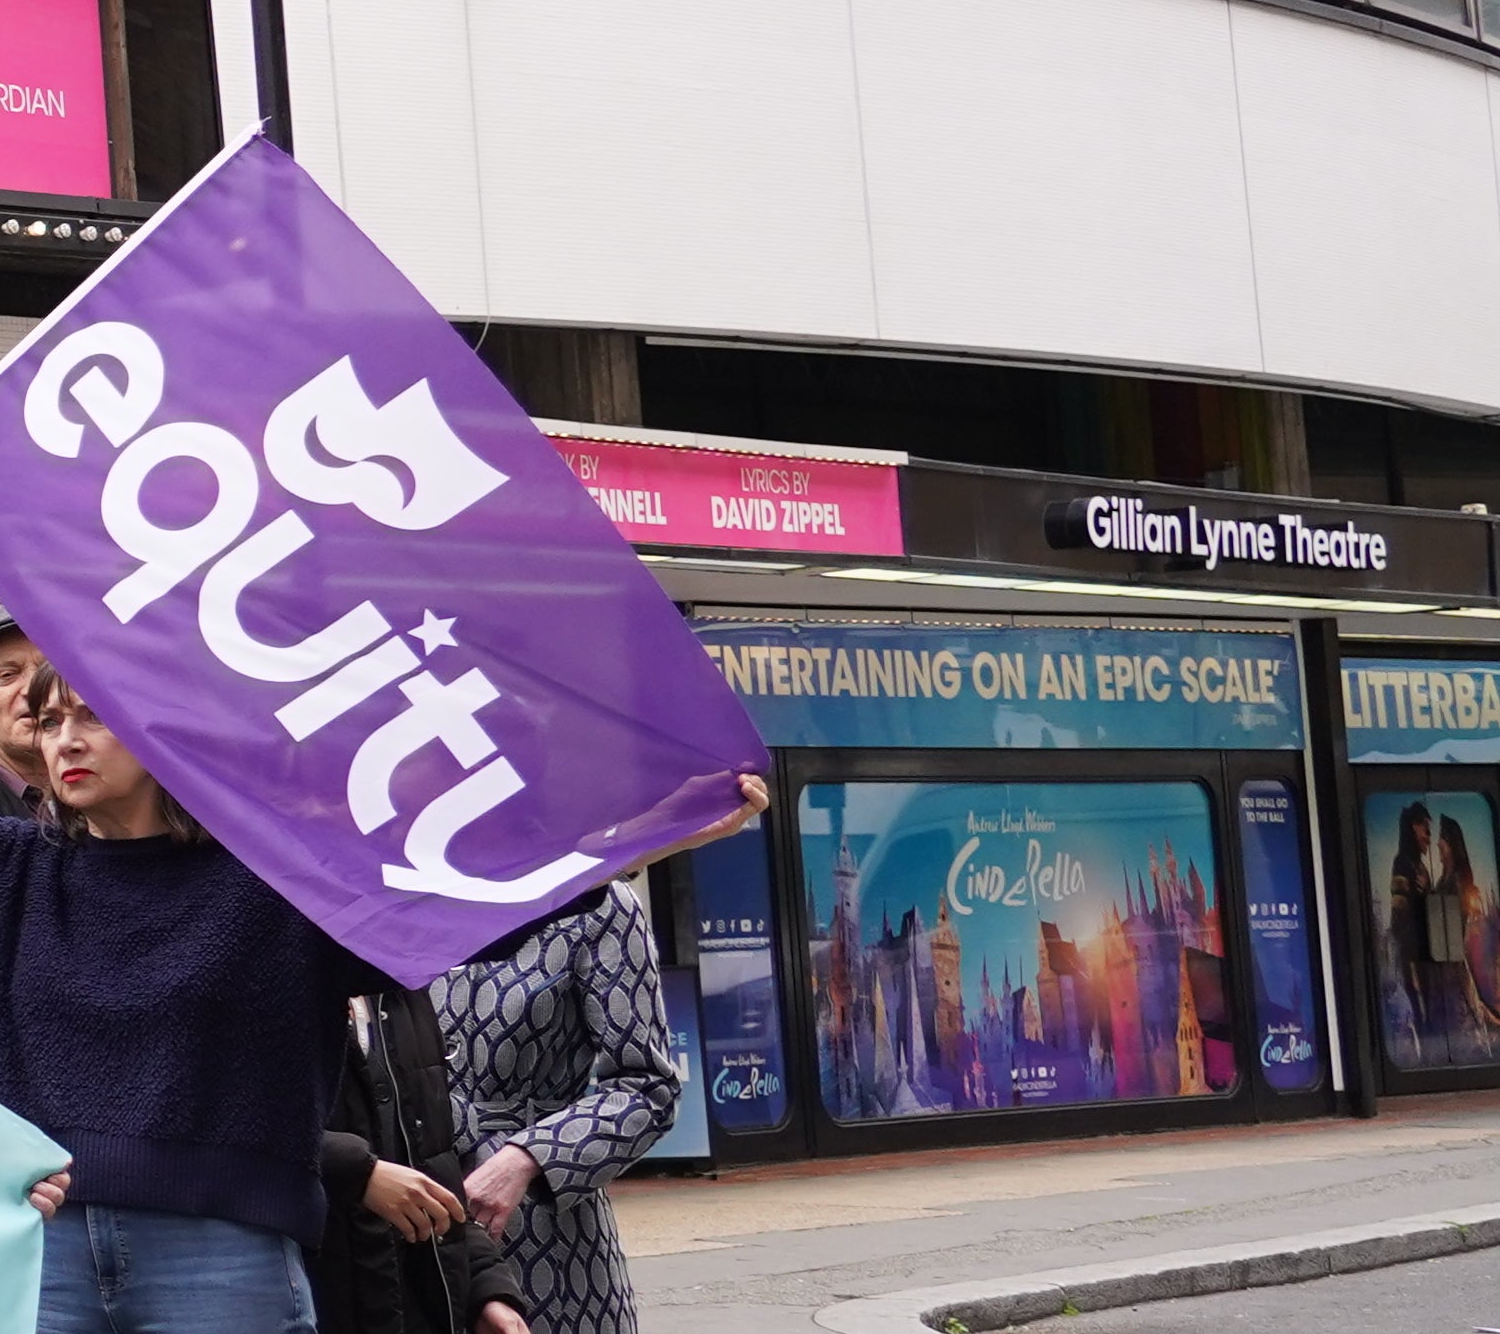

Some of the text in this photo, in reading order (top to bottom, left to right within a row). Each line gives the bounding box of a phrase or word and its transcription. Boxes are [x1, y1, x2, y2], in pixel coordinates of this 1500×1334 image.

[581, 455, 600, 481] BY
[740, 467, 811, 496] LYRICS BY
[710, 495, 846, 536] DAVID ZIPPEL
[1086, 495, 1387, 571] Gillian Lynne Theatre
[972, 652, 1027, 700] ON
[1038, 654, 1087, 701] AN
[1095, 655, 1172, 703] EPIC
[1180, 656, 1282, 704] SCALE'
